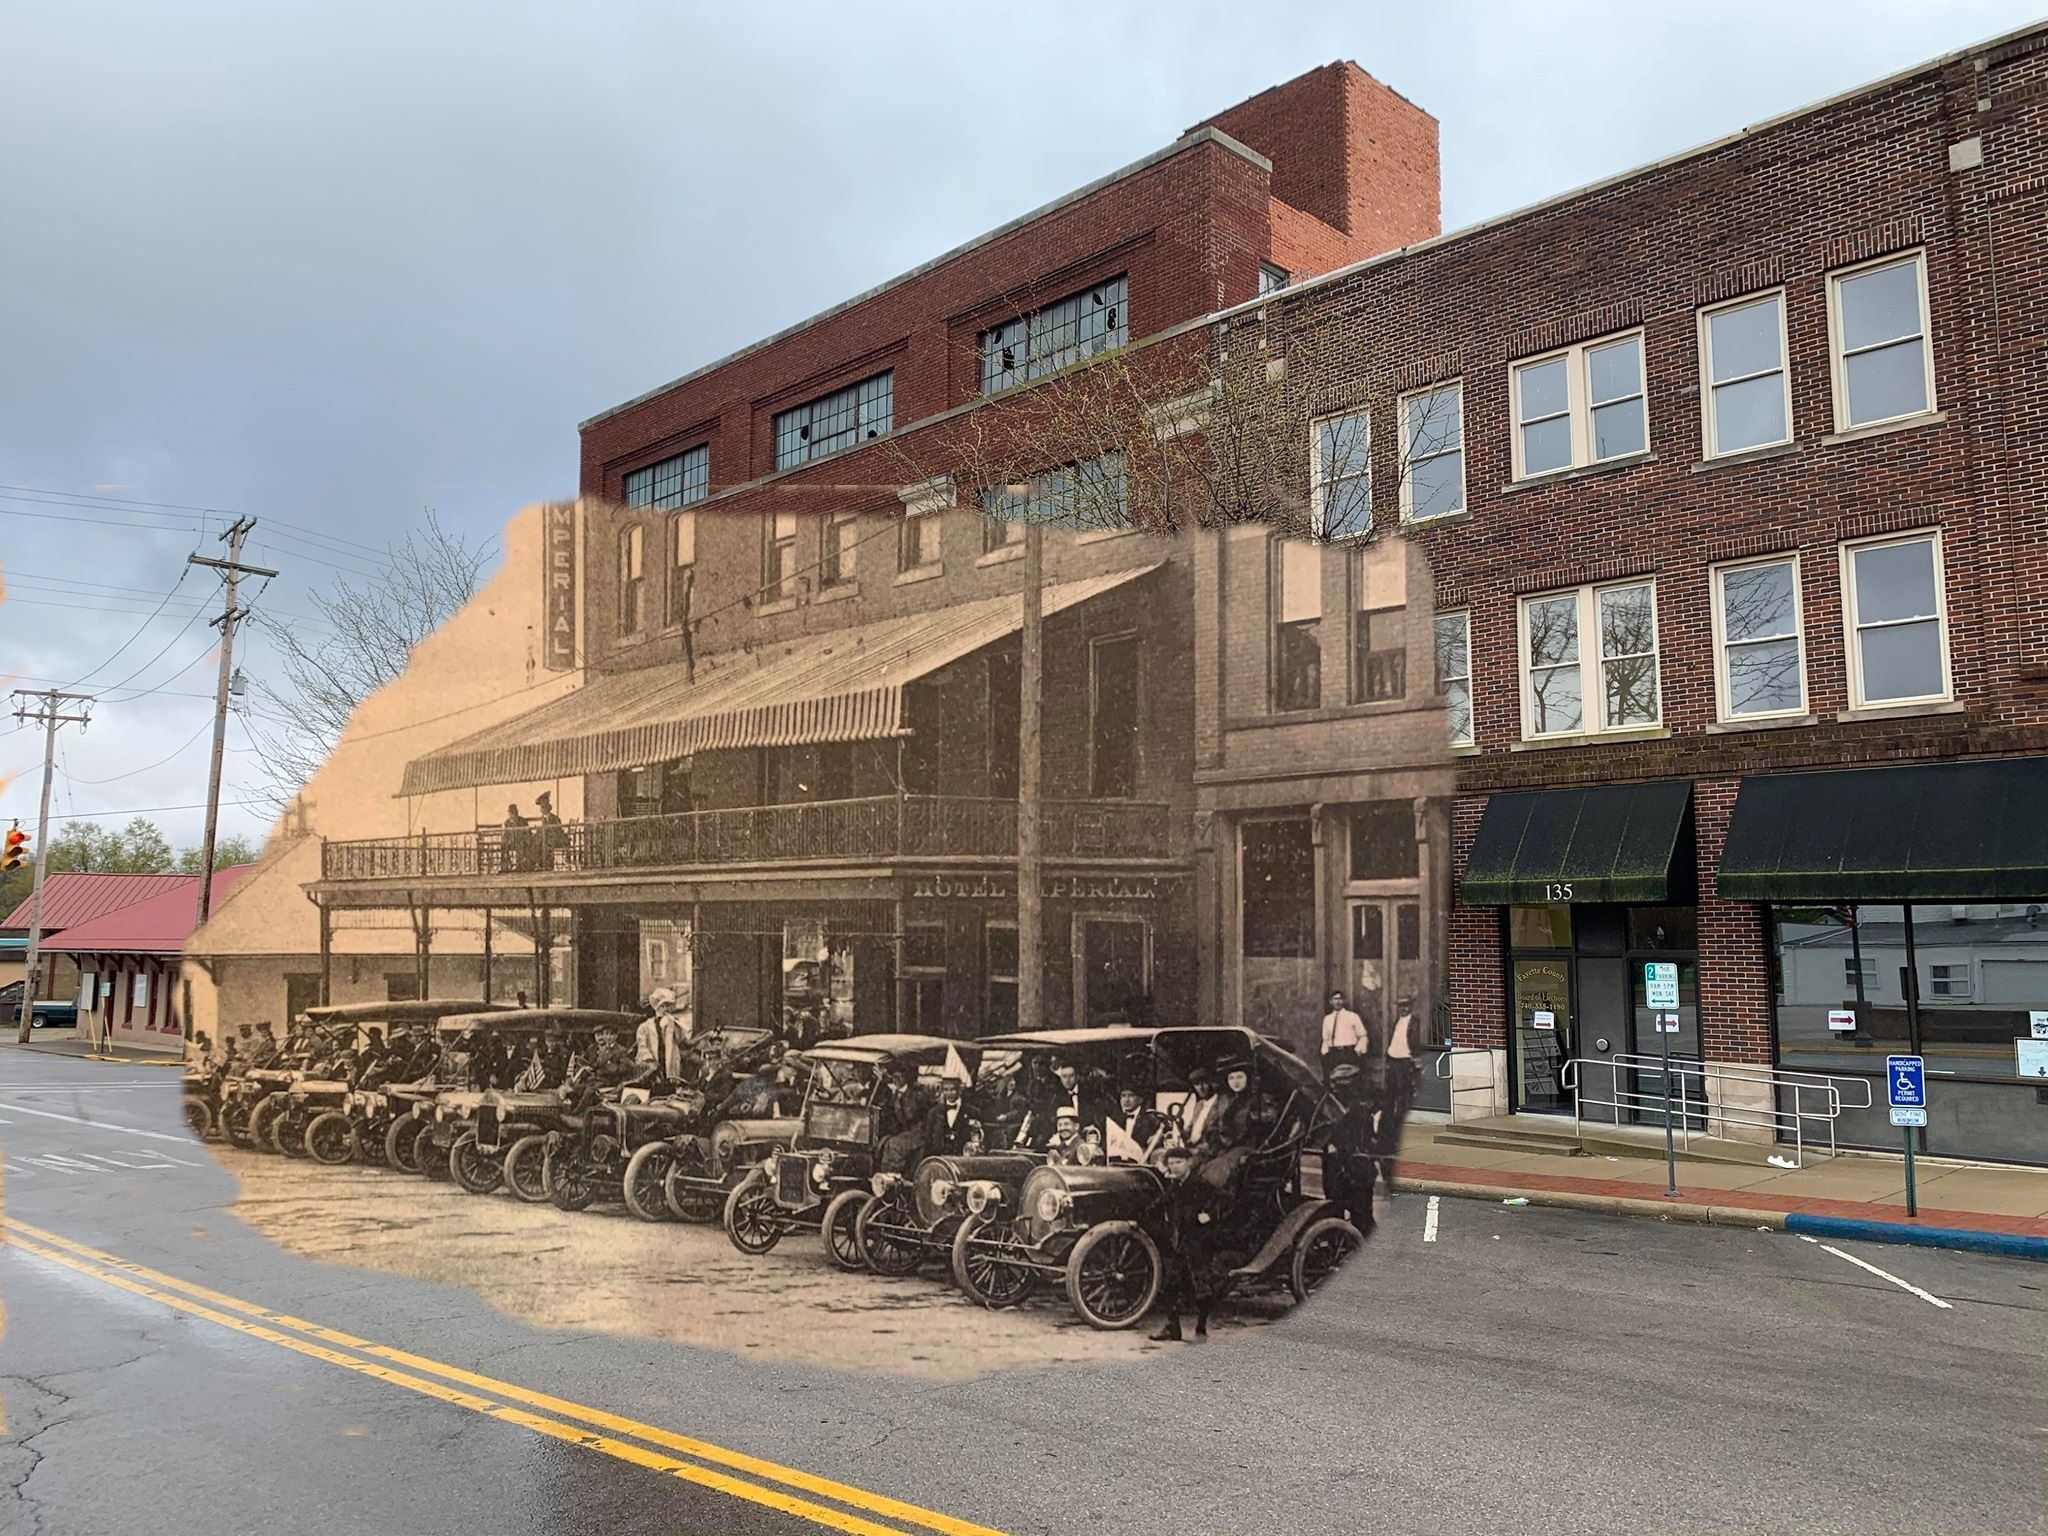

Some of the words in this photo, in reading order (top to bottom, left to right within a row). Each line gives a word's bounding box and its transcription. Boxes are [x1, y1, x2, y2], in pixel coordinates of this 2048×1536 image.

[913, 881, 1006, 898] HOTEL
[1545, 883, 1573, 901] 135
[1516, 967, 1541, 982] Fayette
[1542, 966, 1567, 983] County
[1647, 966, 1655, 979] 2
[1517, 992, 1534, 1001] Board
[1535, 992, 1542, 1001] of
